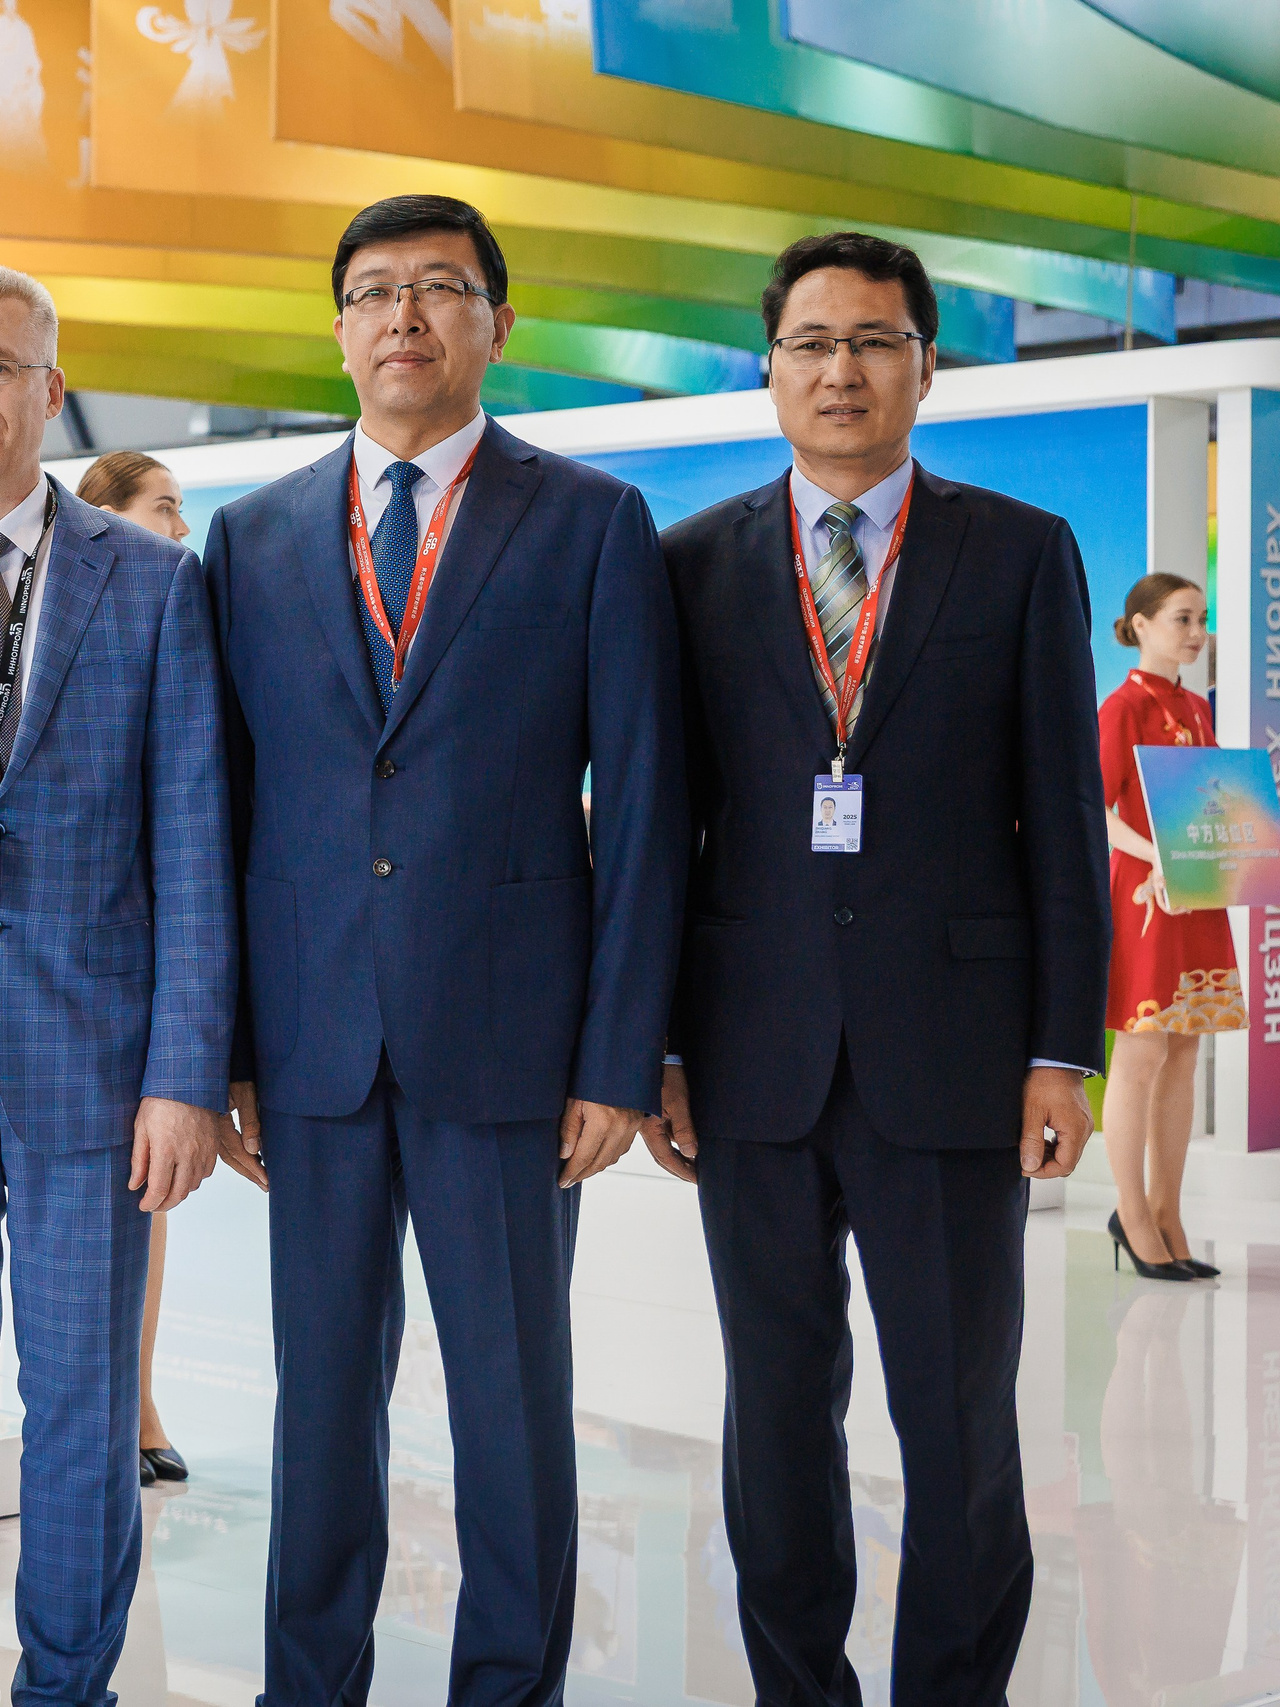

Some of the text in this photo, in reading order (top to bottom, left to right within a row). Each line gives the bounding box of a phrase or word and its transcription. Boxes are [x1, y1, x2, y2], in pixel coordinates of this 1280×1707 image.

[354, 505, 362, 528] EXPO
[422, 532, 435, 555] EXPO
[19, 571, 33, 614] INNOPROM
[8, 627, 23, 676] ИННОПРОМ
